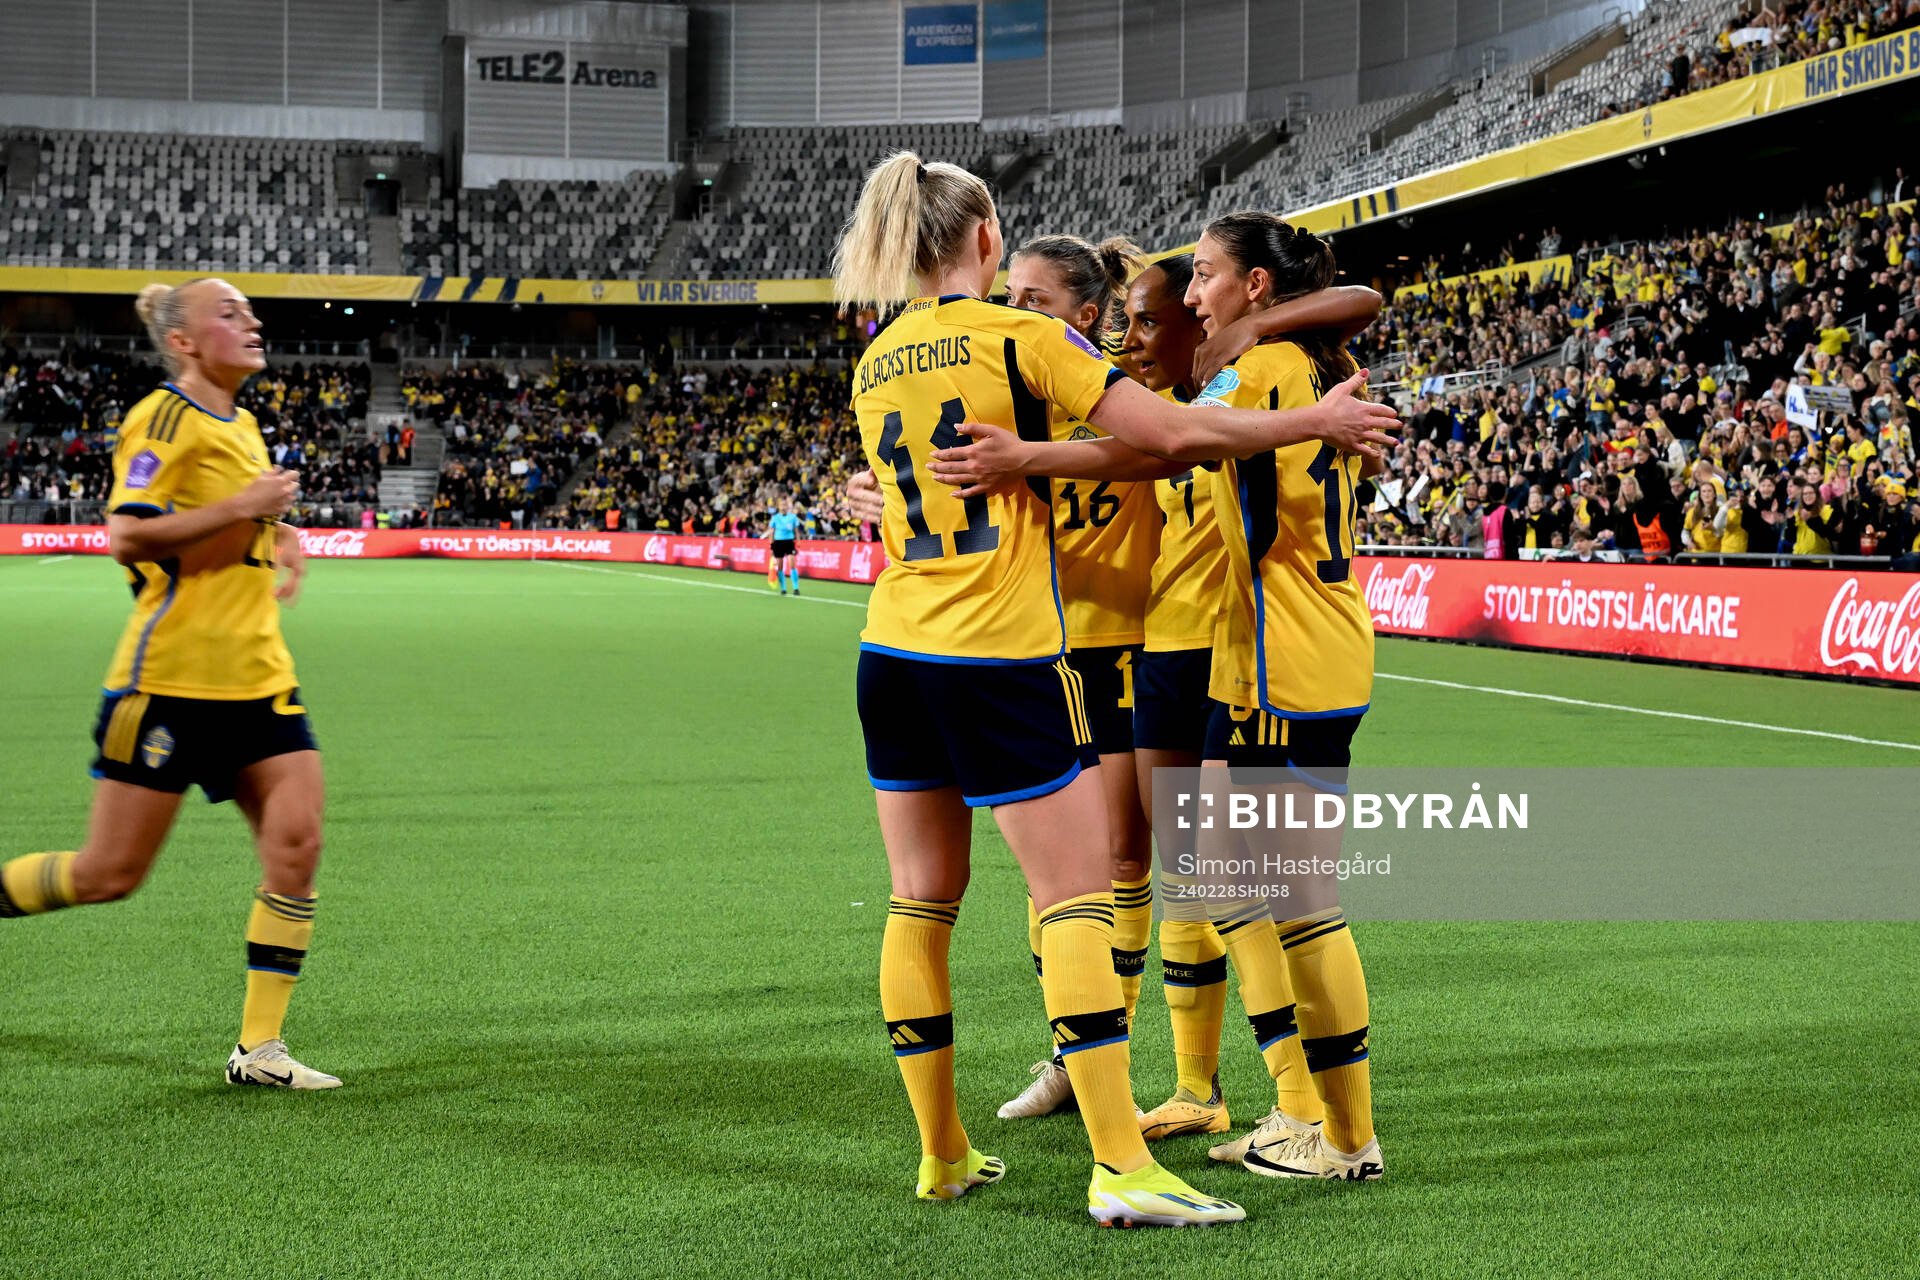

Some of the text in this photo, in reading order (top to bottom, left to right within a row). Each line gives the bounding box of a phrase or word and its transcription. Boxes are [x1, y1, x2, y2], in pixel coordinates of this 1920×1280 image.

[907, 24, 973, 36] AMERICAN
[916, 35, 974, 47] EXPRESS
[477, 51, 658, 88] TELE2 Arena
[1842, 35, 1904, 88] SKRIVS
[638, 281, 757, 302] VI ÄR SVERIGE
[860, 335, 971, 394] BLACKSTENIUS
[877, 397, 1000, 561] 11
[1060, 480, 1119, 529] 16
[22, 533, 78, 548] STOLT
[420, 535, 612, 553] STOLT TÖRSTSLÄCKARE
[1483, 579, 1740, 639] STOLT TÖRSTSLÄCKARE
